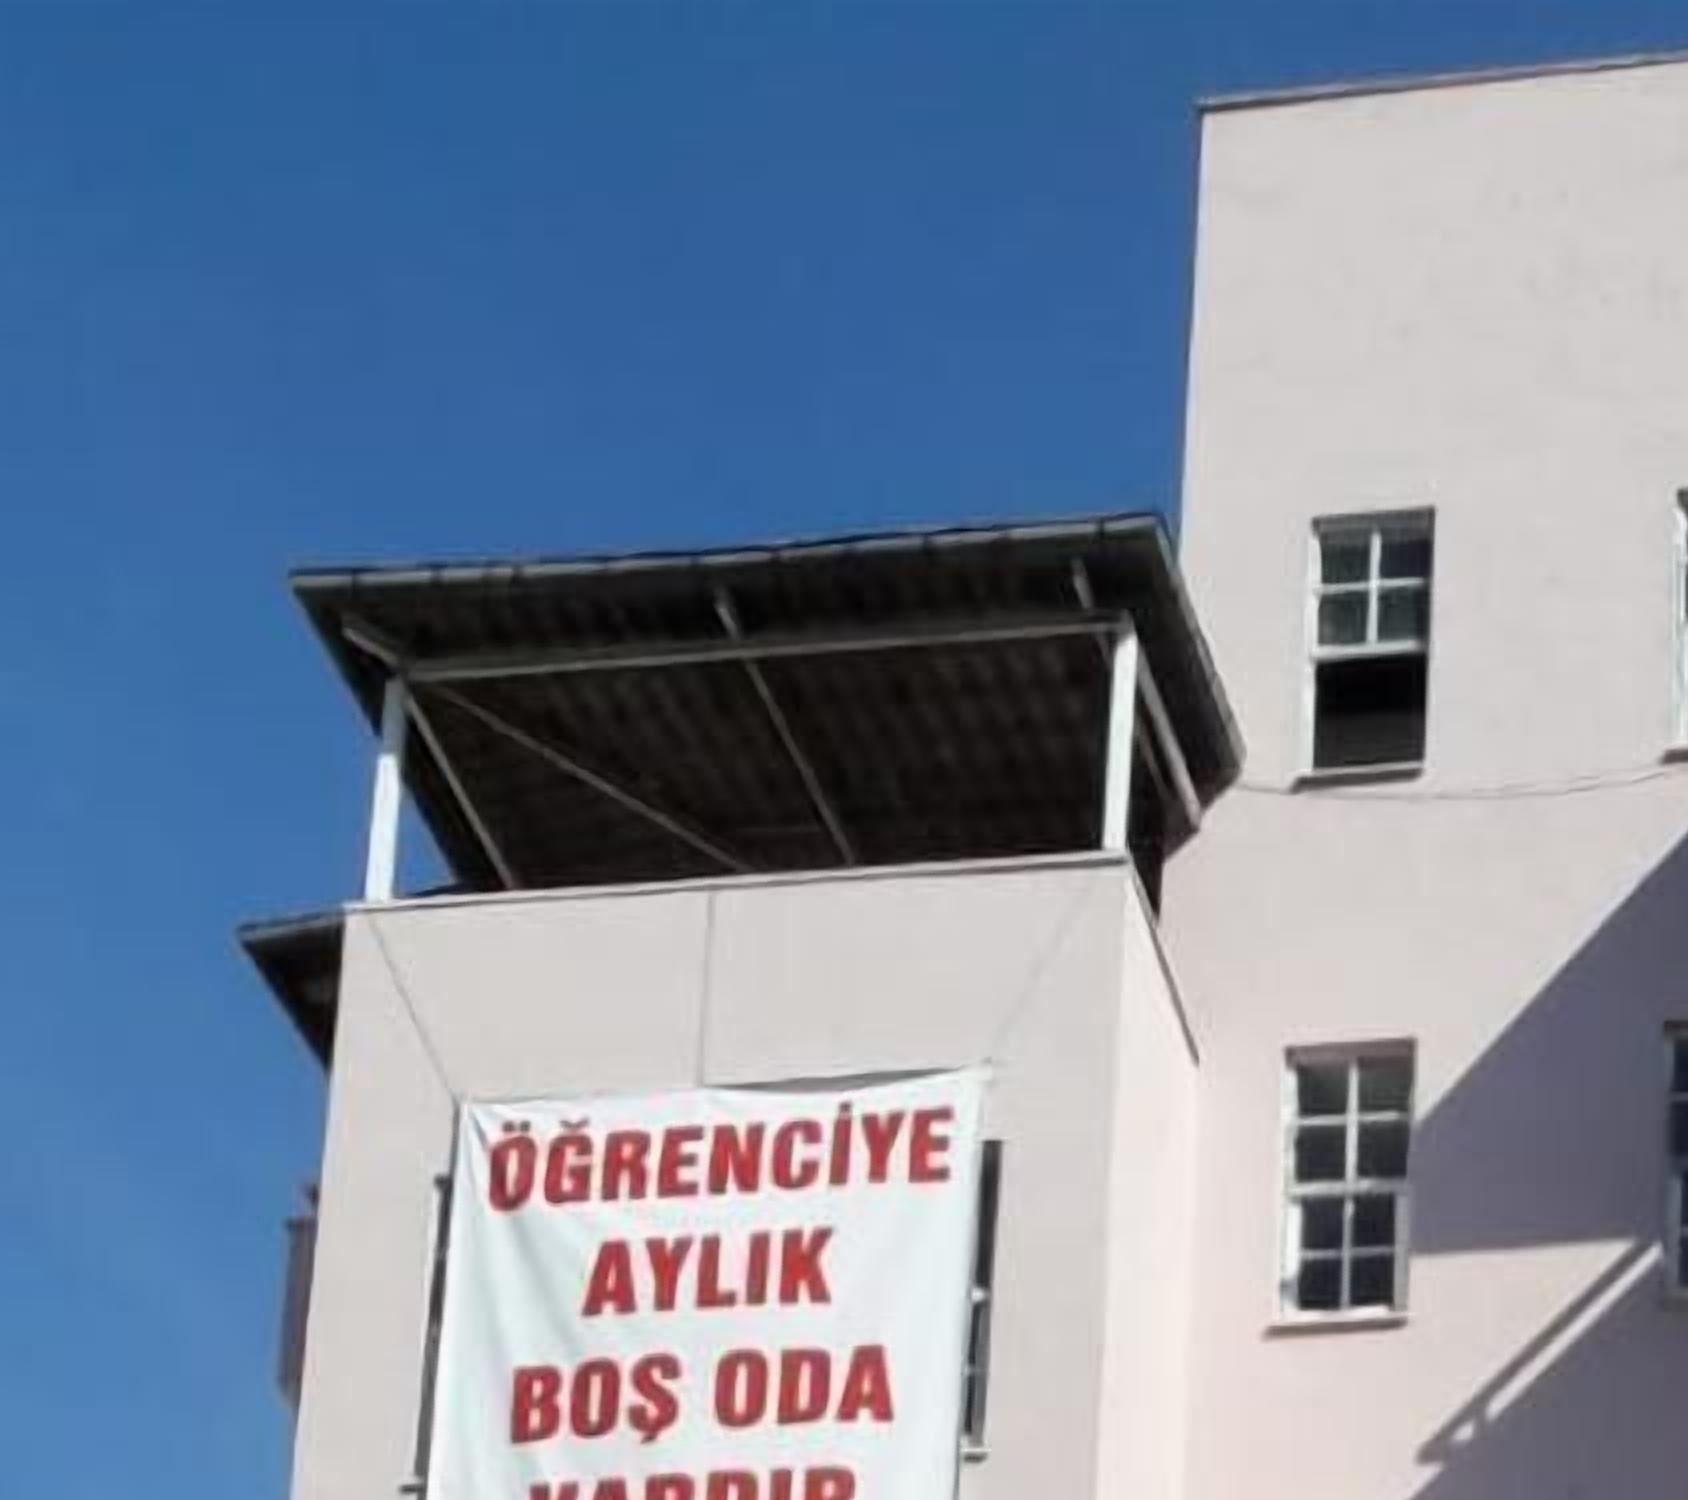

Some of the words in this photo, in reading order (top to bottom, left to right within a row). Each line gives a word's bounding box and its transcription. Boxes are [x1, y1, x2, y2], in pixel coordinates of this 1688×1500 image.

[487, 1101, 956, 1212] ÖĞRENCİYE
[581, 1226, 834, 1316] AYLIK
[510, 1352, 682, 1444] BOŞ
[713, 1344, 895, 1428] ODA
